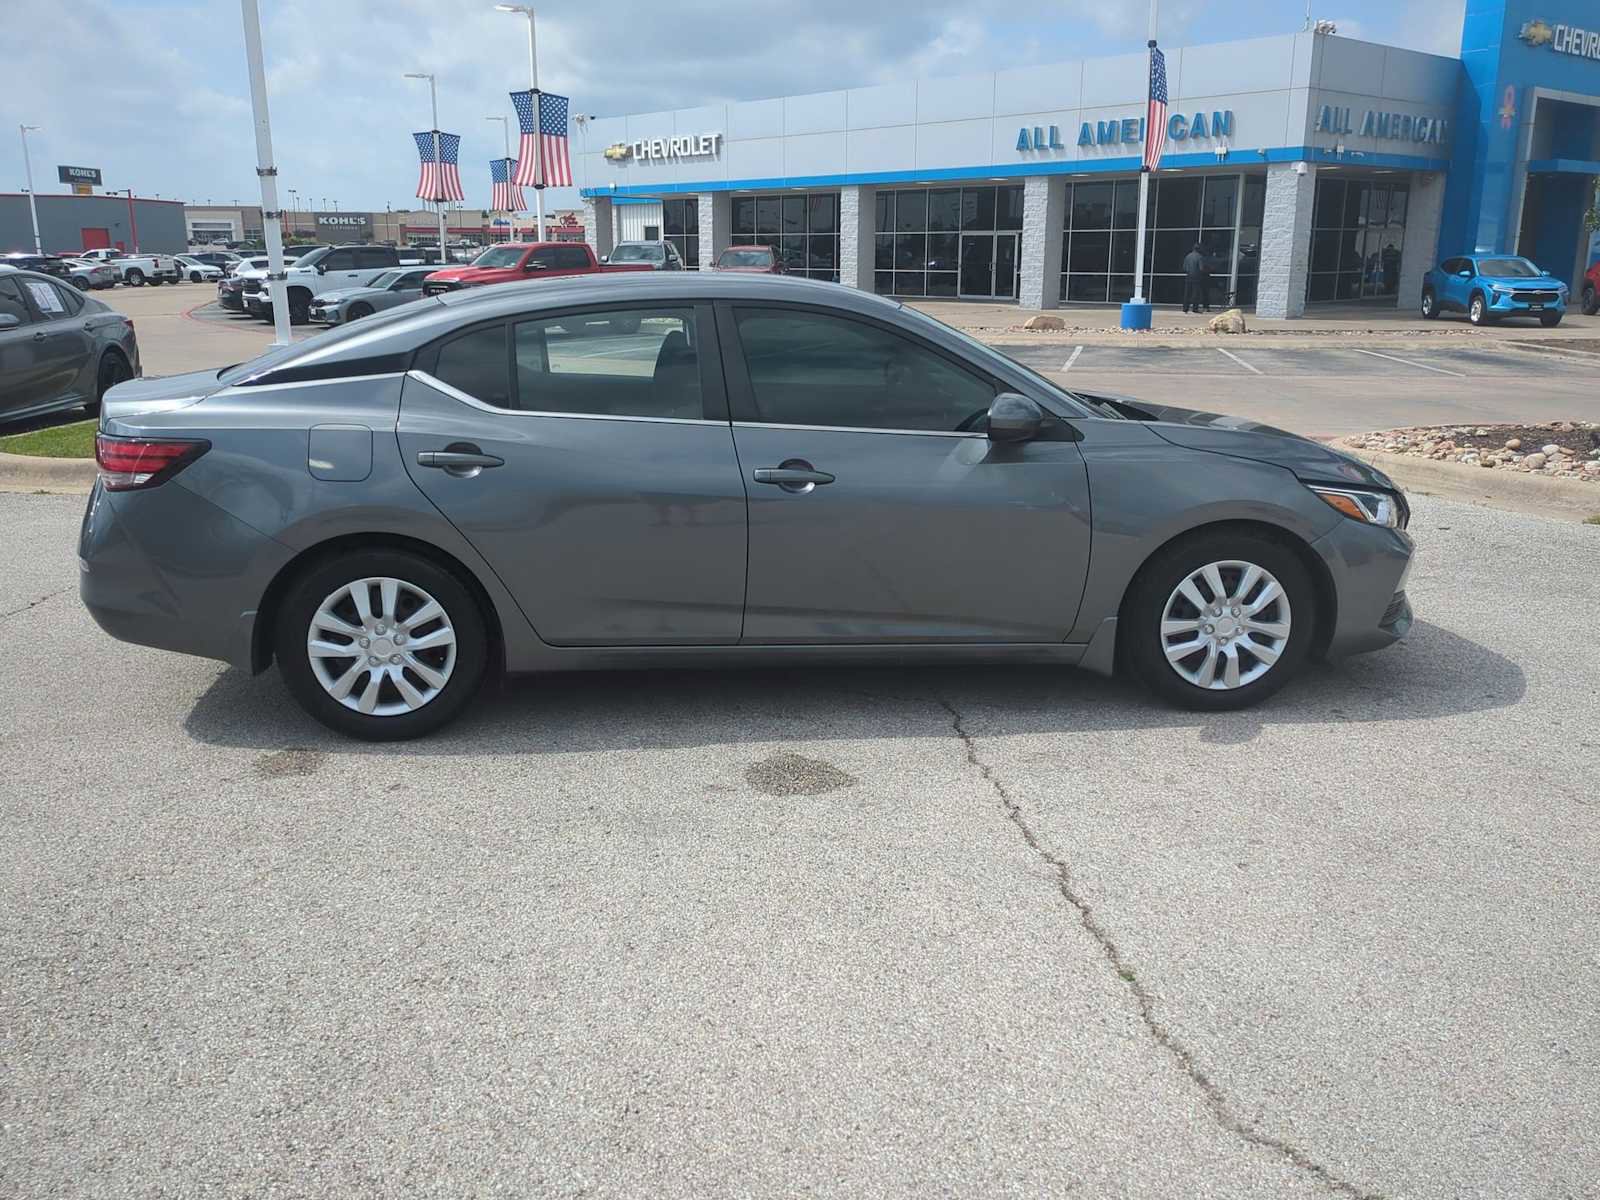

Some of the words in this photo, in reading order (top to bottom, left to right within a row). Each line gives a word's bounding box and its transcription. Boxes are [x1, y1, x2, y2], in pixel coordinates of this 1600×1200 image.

[1016, 125, 1064, 151] ALL
[1077, 110, 1233, 147] AMECAN
[1316, 105, 1352, 134] ALL
[1360, 110, 1448, 144] AMERICAN
[632, 134, 721, 160] CHEVROLET
[69, 168, 97, 178] KOHL'S
[318, 216, 367, 225] KOHL'S
